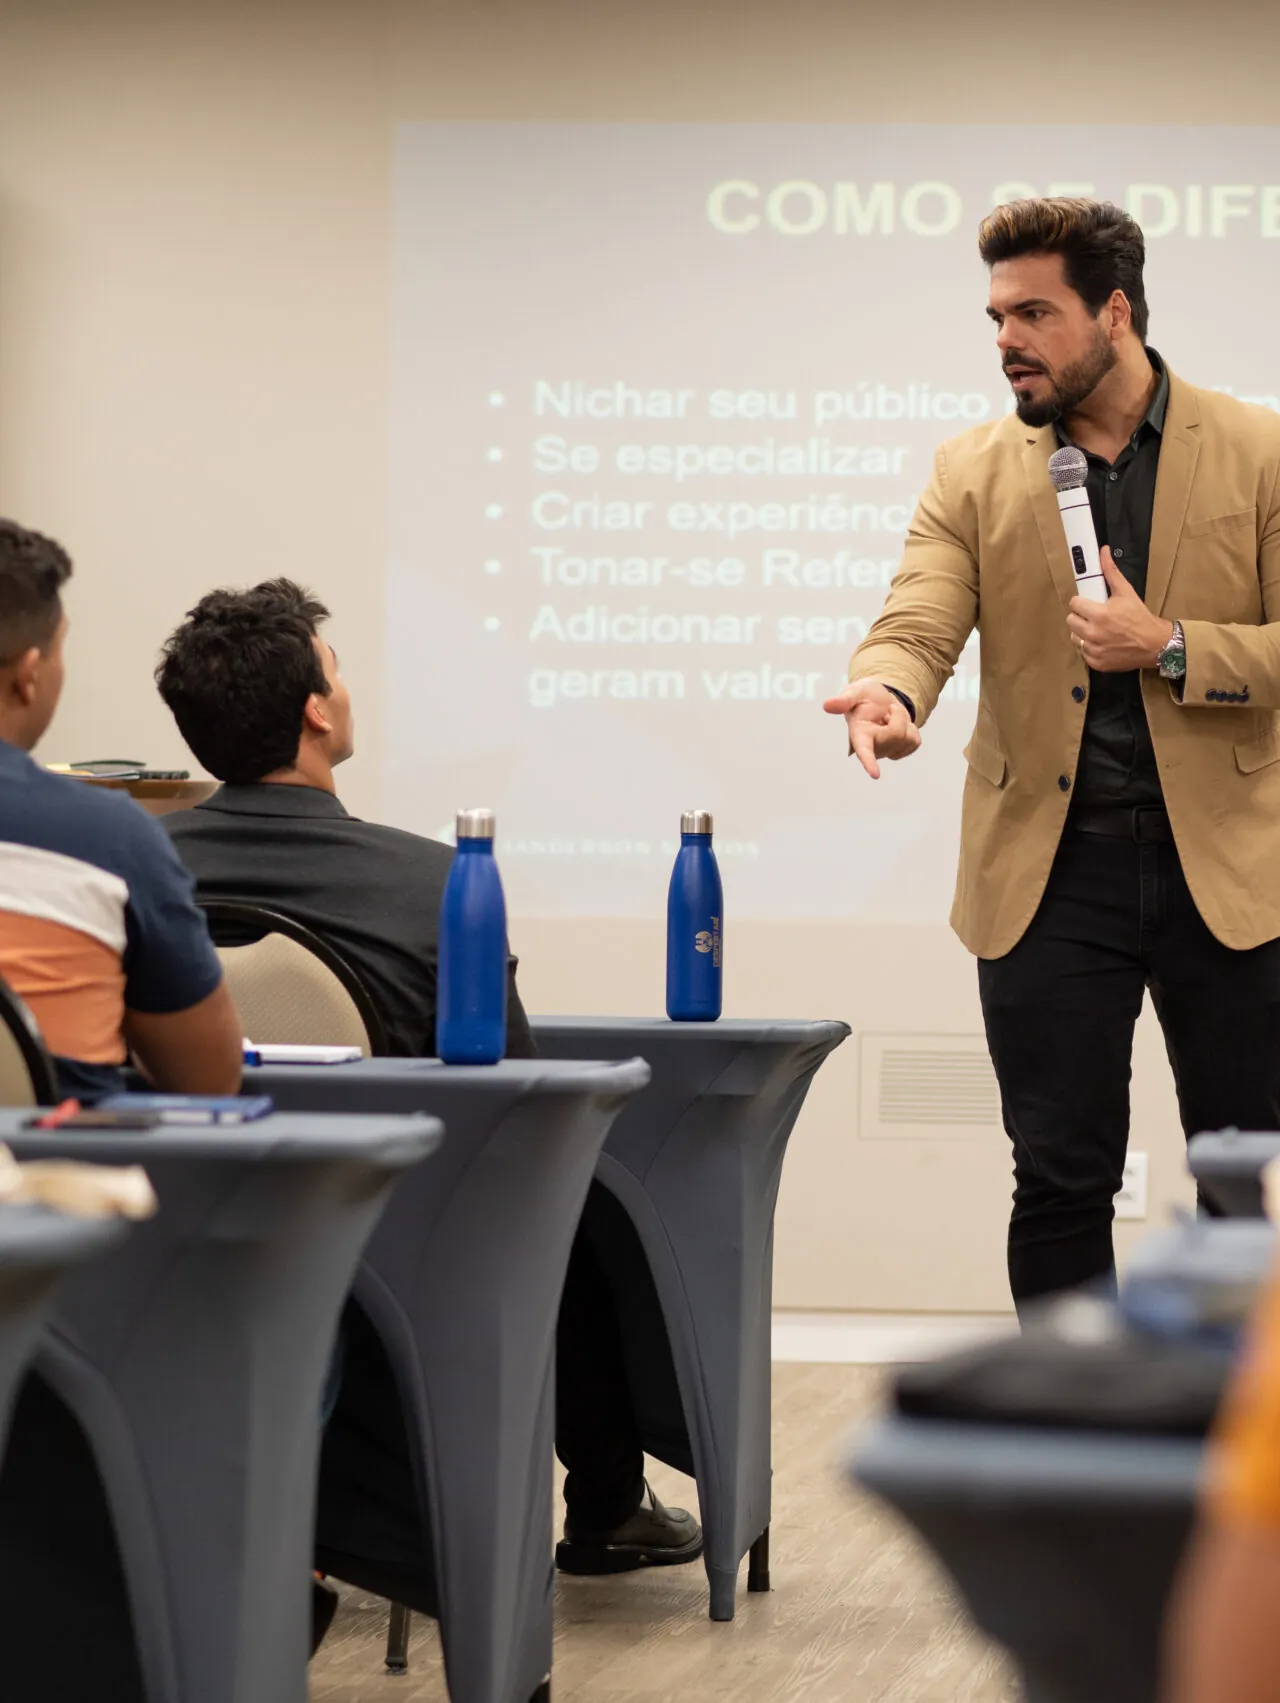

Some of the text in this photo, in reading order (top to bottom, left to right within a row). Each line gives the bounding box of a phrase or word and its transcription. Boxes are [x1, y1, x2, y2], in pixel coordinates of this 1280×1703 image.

[707, 179, 963, 237] COMO
[533, 381, 691, 419] Nichar
[708, 391, 797, 420] seu
[813, 382, 991, 427] público
[532, 436, 909, 482] Se especializar
[531, 491, 651, 531] Criar
[532, 546, 903, 588] Tonar-se Refer
[528, 604, 762, 643] Adicionar
[528, 671, 686, 709] geram
[702, 663, 822, 701] valor
